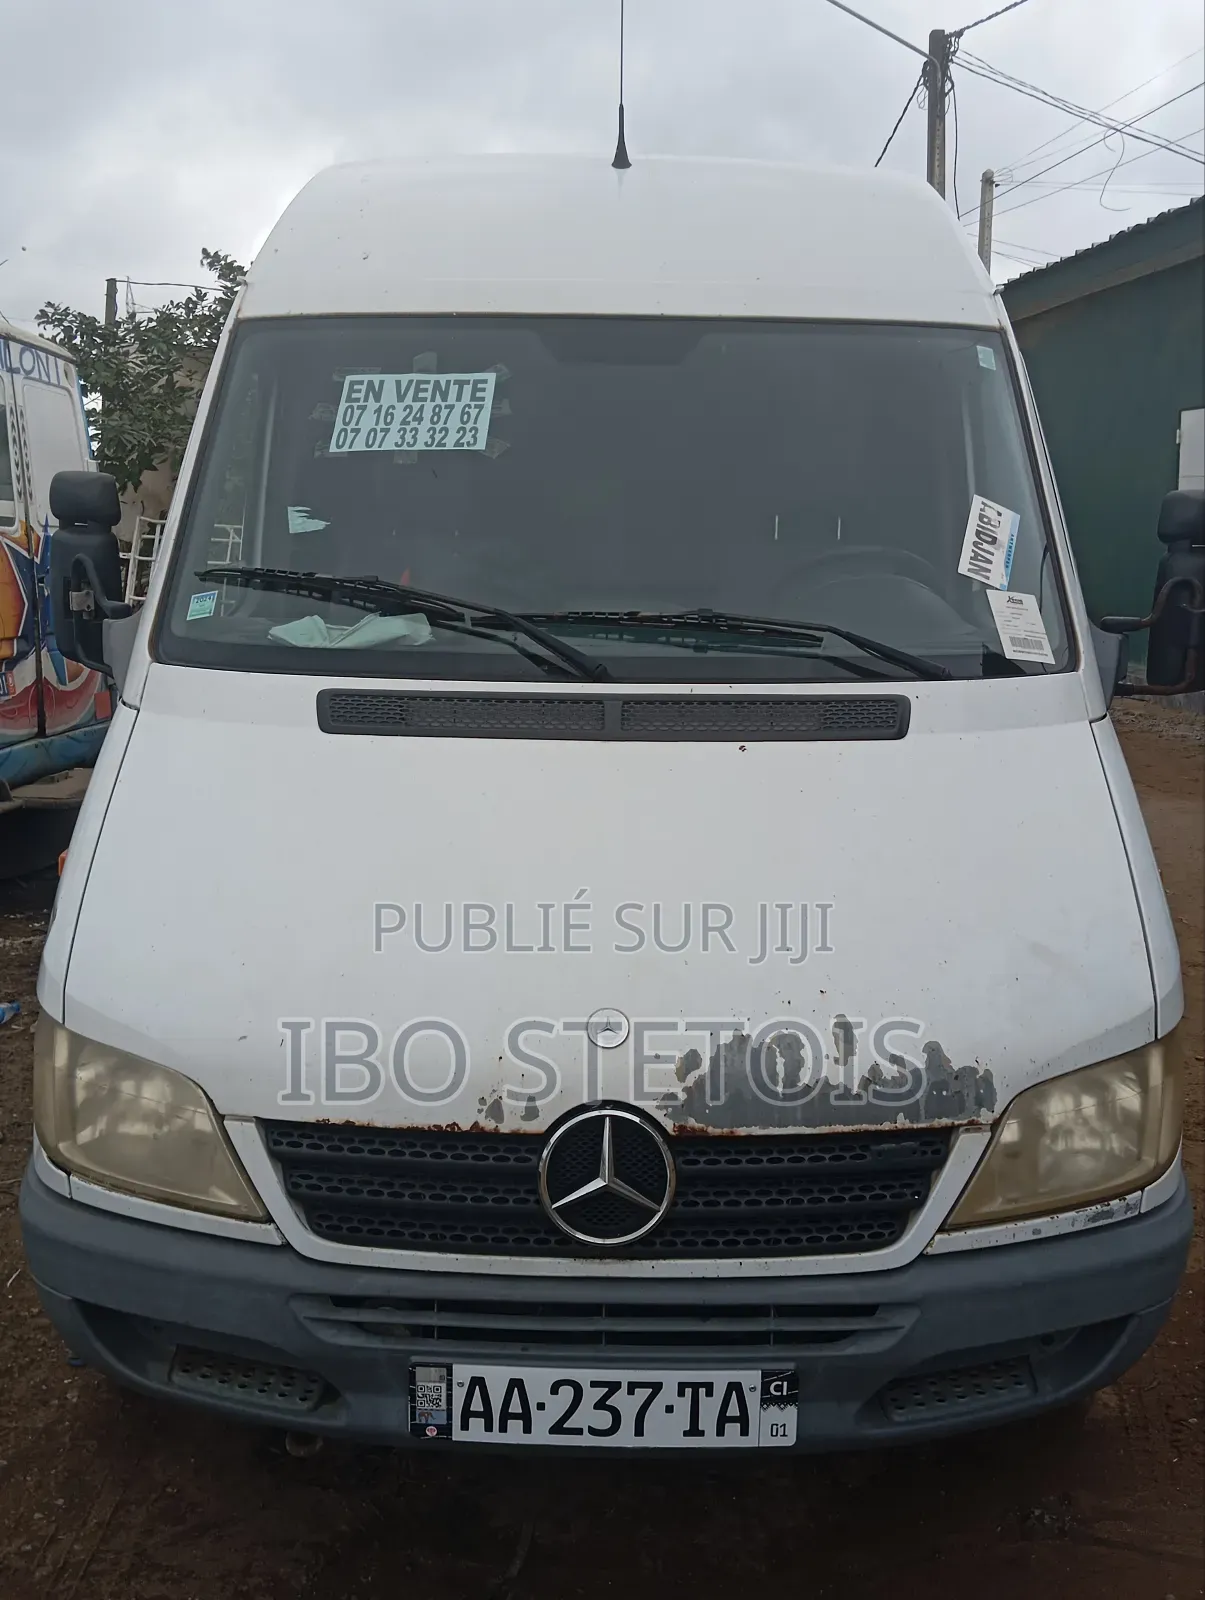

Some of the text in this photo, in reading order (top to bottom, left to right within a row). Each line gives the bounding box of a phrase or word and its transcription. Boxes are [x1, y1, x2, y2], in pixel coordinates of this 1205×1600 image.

[345, 379, 488, 403] EN VENTE
[342, 403, 484, 426] 07 16 24 87 67
[336, 426, 479, 449] 07 07 33 32 23
[769, 1381, 788, 1396] CI
[770, 1423, 788, 1437] 01
